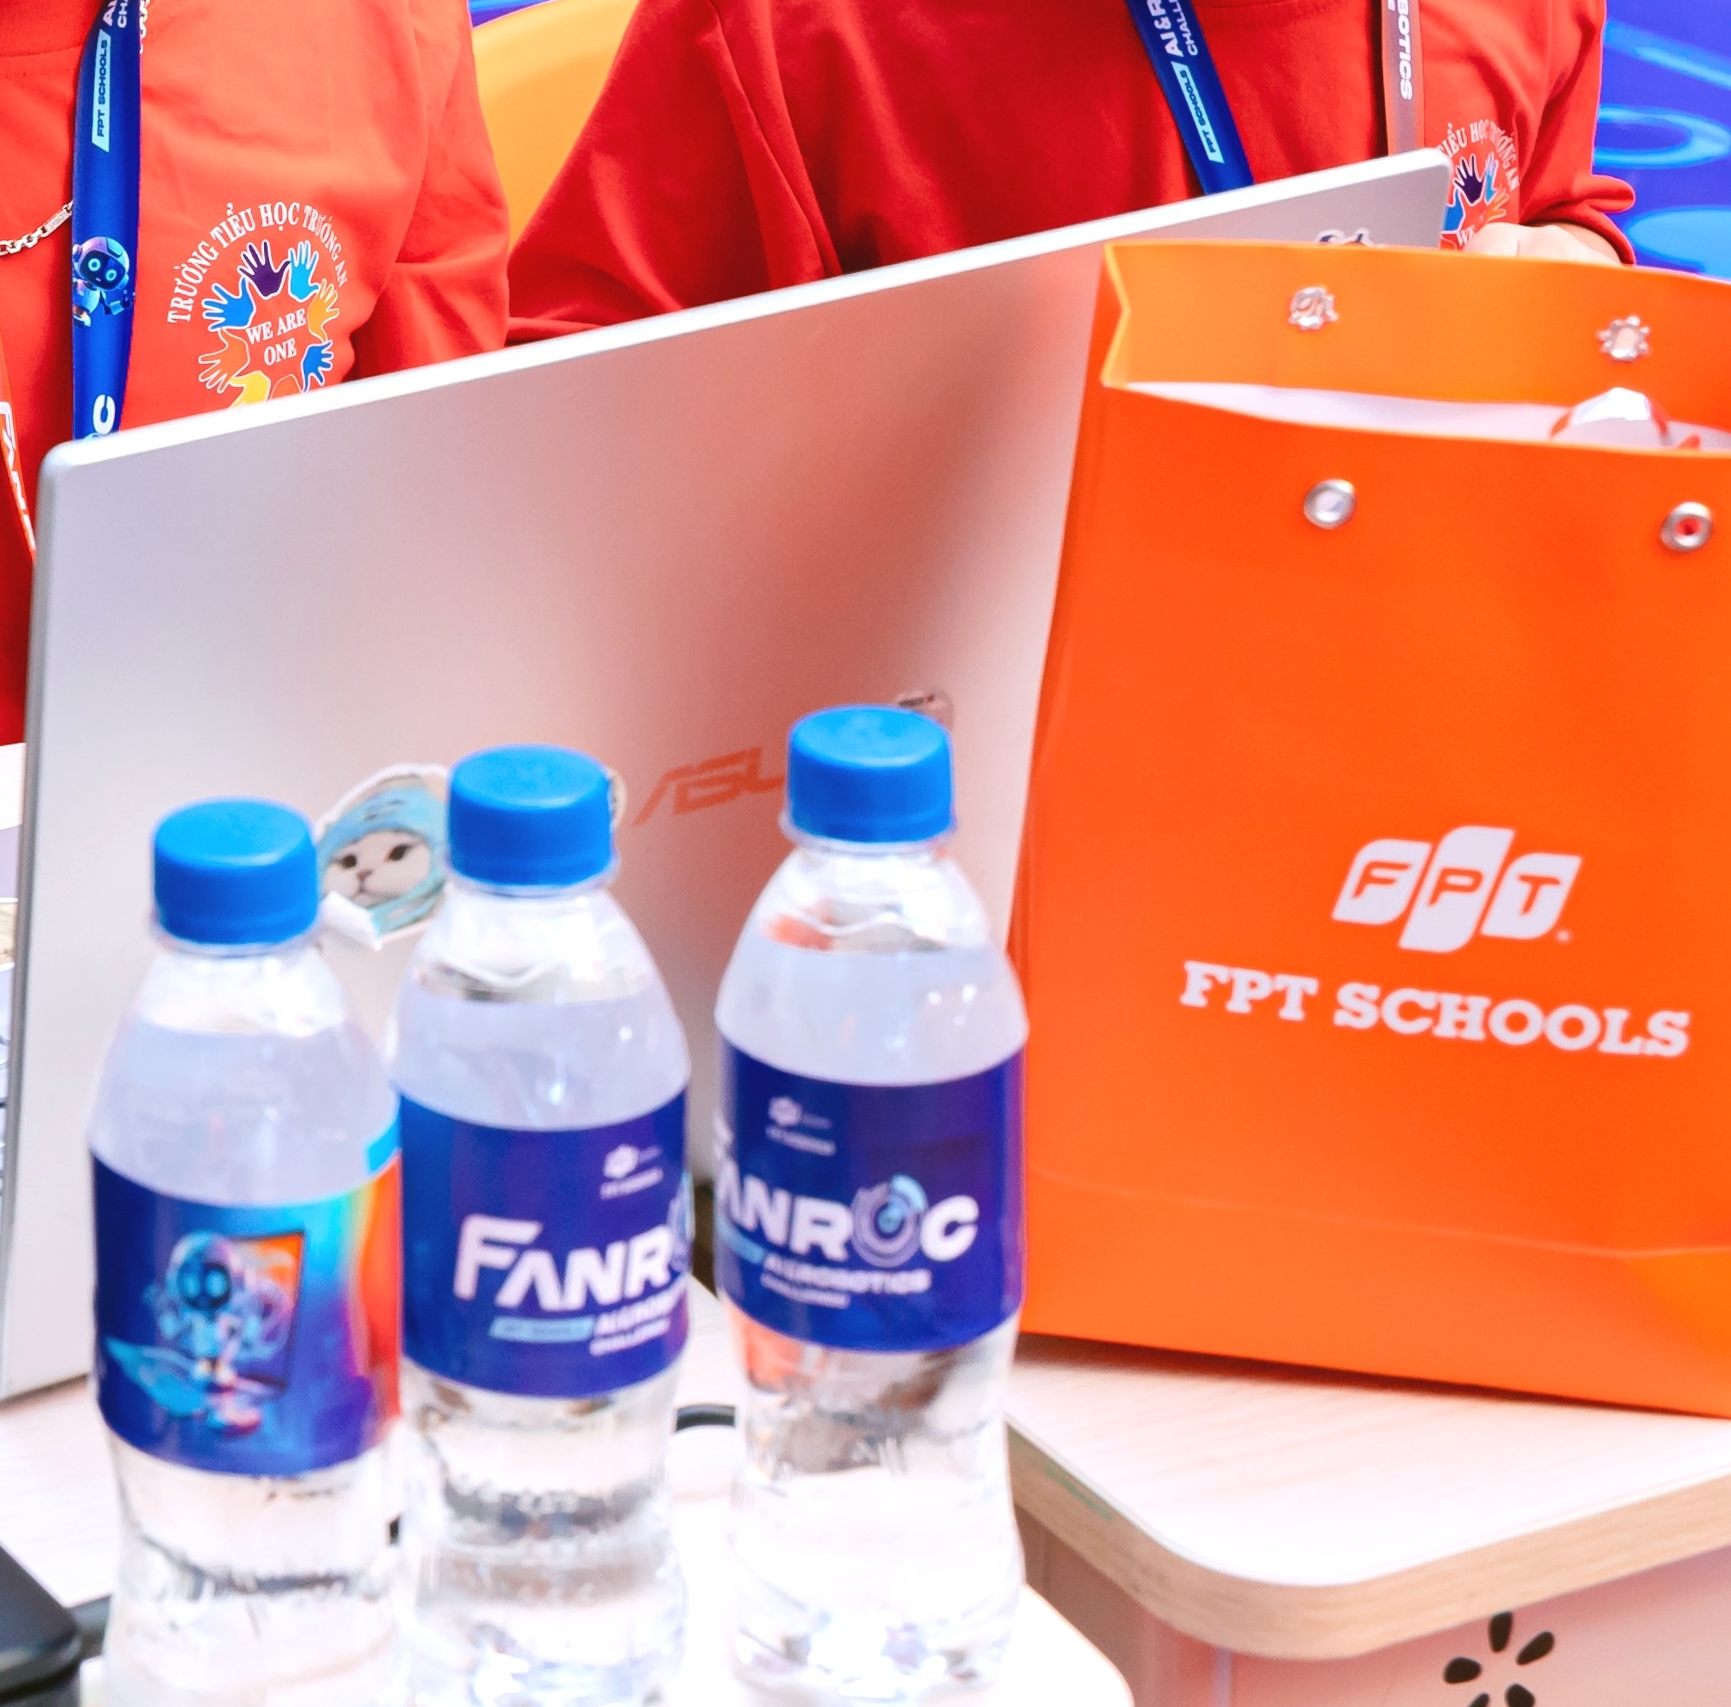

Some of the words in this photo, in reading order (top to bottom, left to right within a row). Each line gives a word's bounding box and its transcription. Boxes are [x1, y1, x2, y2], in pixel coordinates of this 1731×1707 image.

[167, 241, 219, 324] TRƯỜNG
[210, 202, 256, 249] TIỂU
[258, 201, 300, 232] HỌC
[334, 260, 348, 288] AN
[245, 321, 274, 345] WE
[277, 308, 307, 337] ARE
[264, 338, 298, 366] ONE
[1339, 844, 1573, 935] FPT
[1179, 960, 1319, 1022] FPT
[1333, 981, 1691, 1058] SCHOOLS
